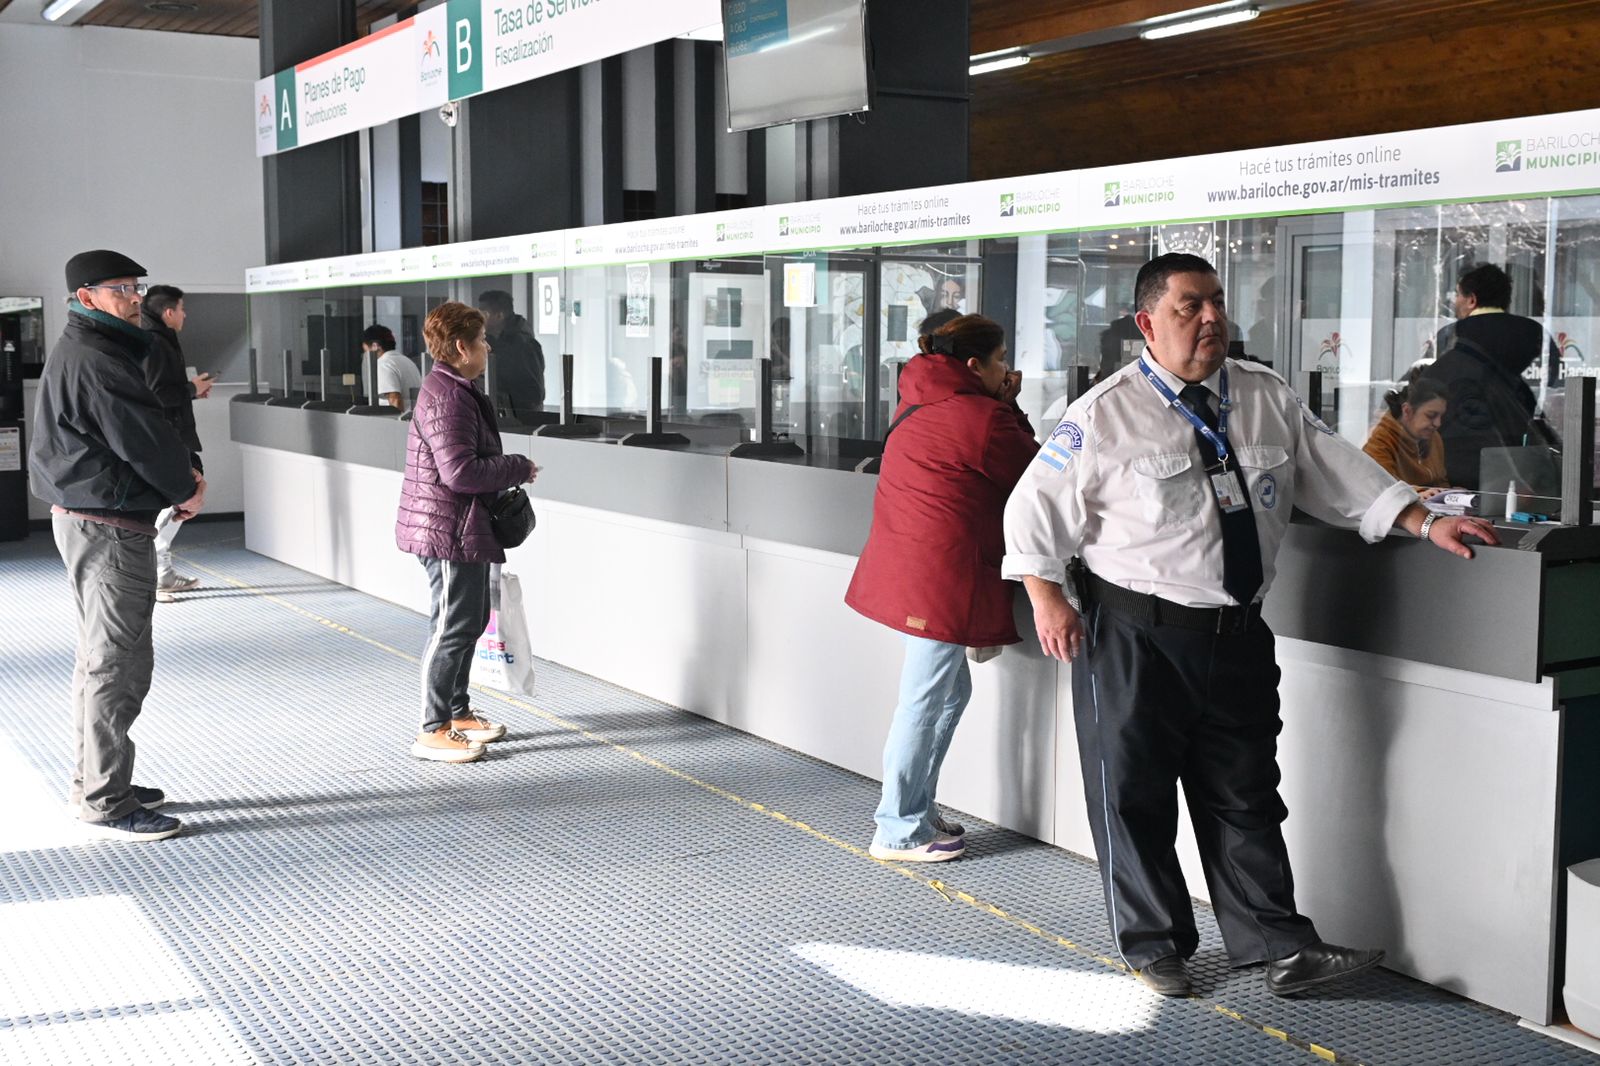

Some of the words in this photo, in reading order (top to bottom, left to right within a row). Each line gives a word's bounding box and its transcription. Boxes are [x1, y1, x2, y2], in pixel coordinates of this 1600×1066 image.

[494, 7, 524, 36] Tasa
[526, 1, 544, 26] de
[456, 18, 472, 74] B
[495, 31, 554, 67] Fiscalización
[304, 80, 330, 104] Planes
[331, 71, 342, 94] de
[343, 66, 366, 93] Pago
[281, 88, 293, 131] A
[304, 102, 348, 127] Contribuciones
[1526, 132, 1600, 152] BARILOCH
[1239, 157, 1271, 176] Hacé
[1275, 158, 1294, 173] tus
[1297, 151, 1353, 171] trámites
[1356, 145, 1402, 165] online
[1526, 151, 1600, 170] MUNICIPI
[1123, 175, 1175, 192] BARILOCHE
[1207, 169, 1441, 203] www.bariloche.gov.ar/mis-tramites
[857, 202, 876, 216] Hacé
[878, 202, 889, 214] tus
[923, 195, 949, 209] online
[1016, 202, 1061, 216] MUNICIPIO
[1123, 191, 1175, 206] MUNICIPIO
[790, 223, 822, 235] MUNICIPIO
[840, 213, 971, 235] www.bariloche.gov.ar/mis-tramites
[544, 284, 553, 316] B
